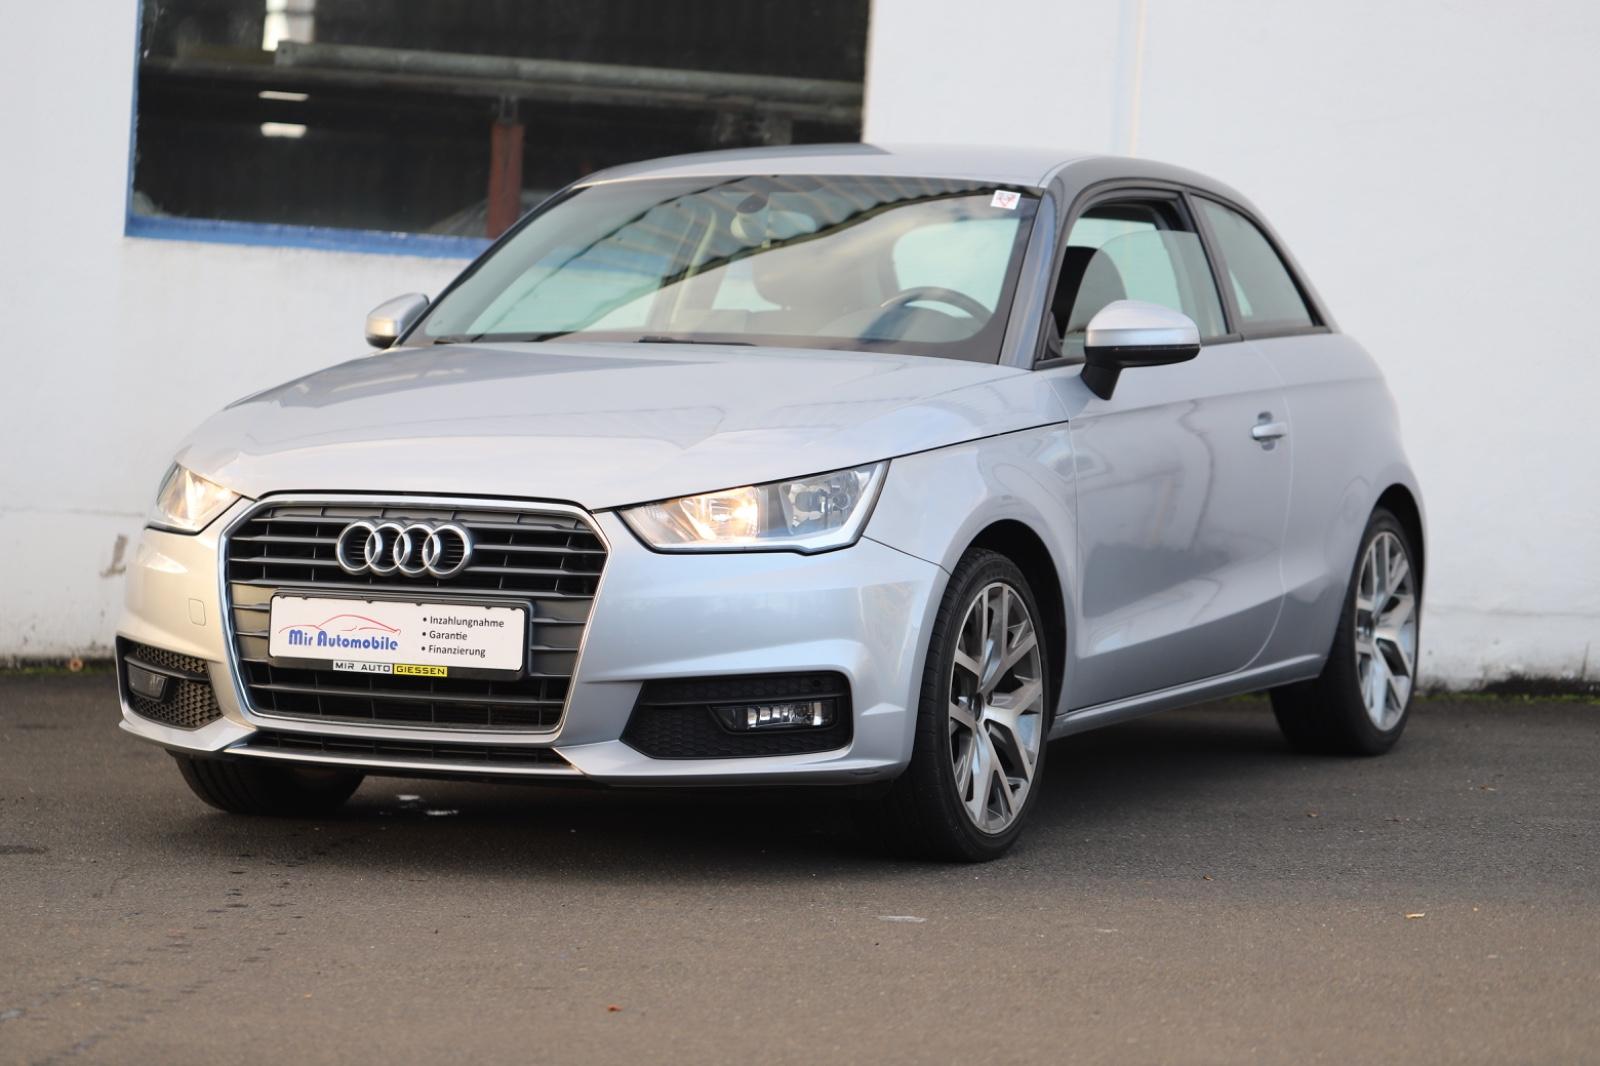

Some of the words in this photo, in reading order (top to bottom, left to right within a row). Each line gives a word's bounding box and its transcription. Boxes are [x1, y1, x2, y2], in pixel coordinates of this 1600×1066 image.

[430, 616, 504, 628] Inzahlungnahme
[289, 629, 314, 646] Mir
[317, 629, 399, 650] Automobile
[430, 631, 468, 641] Garantie
[428, 645, 486, 657] Finanzierung
[335, 662, 355, 670] MIR
[361, 664, 391, 672] AUTO
[396, 665, 446, 675] GIESSEN
